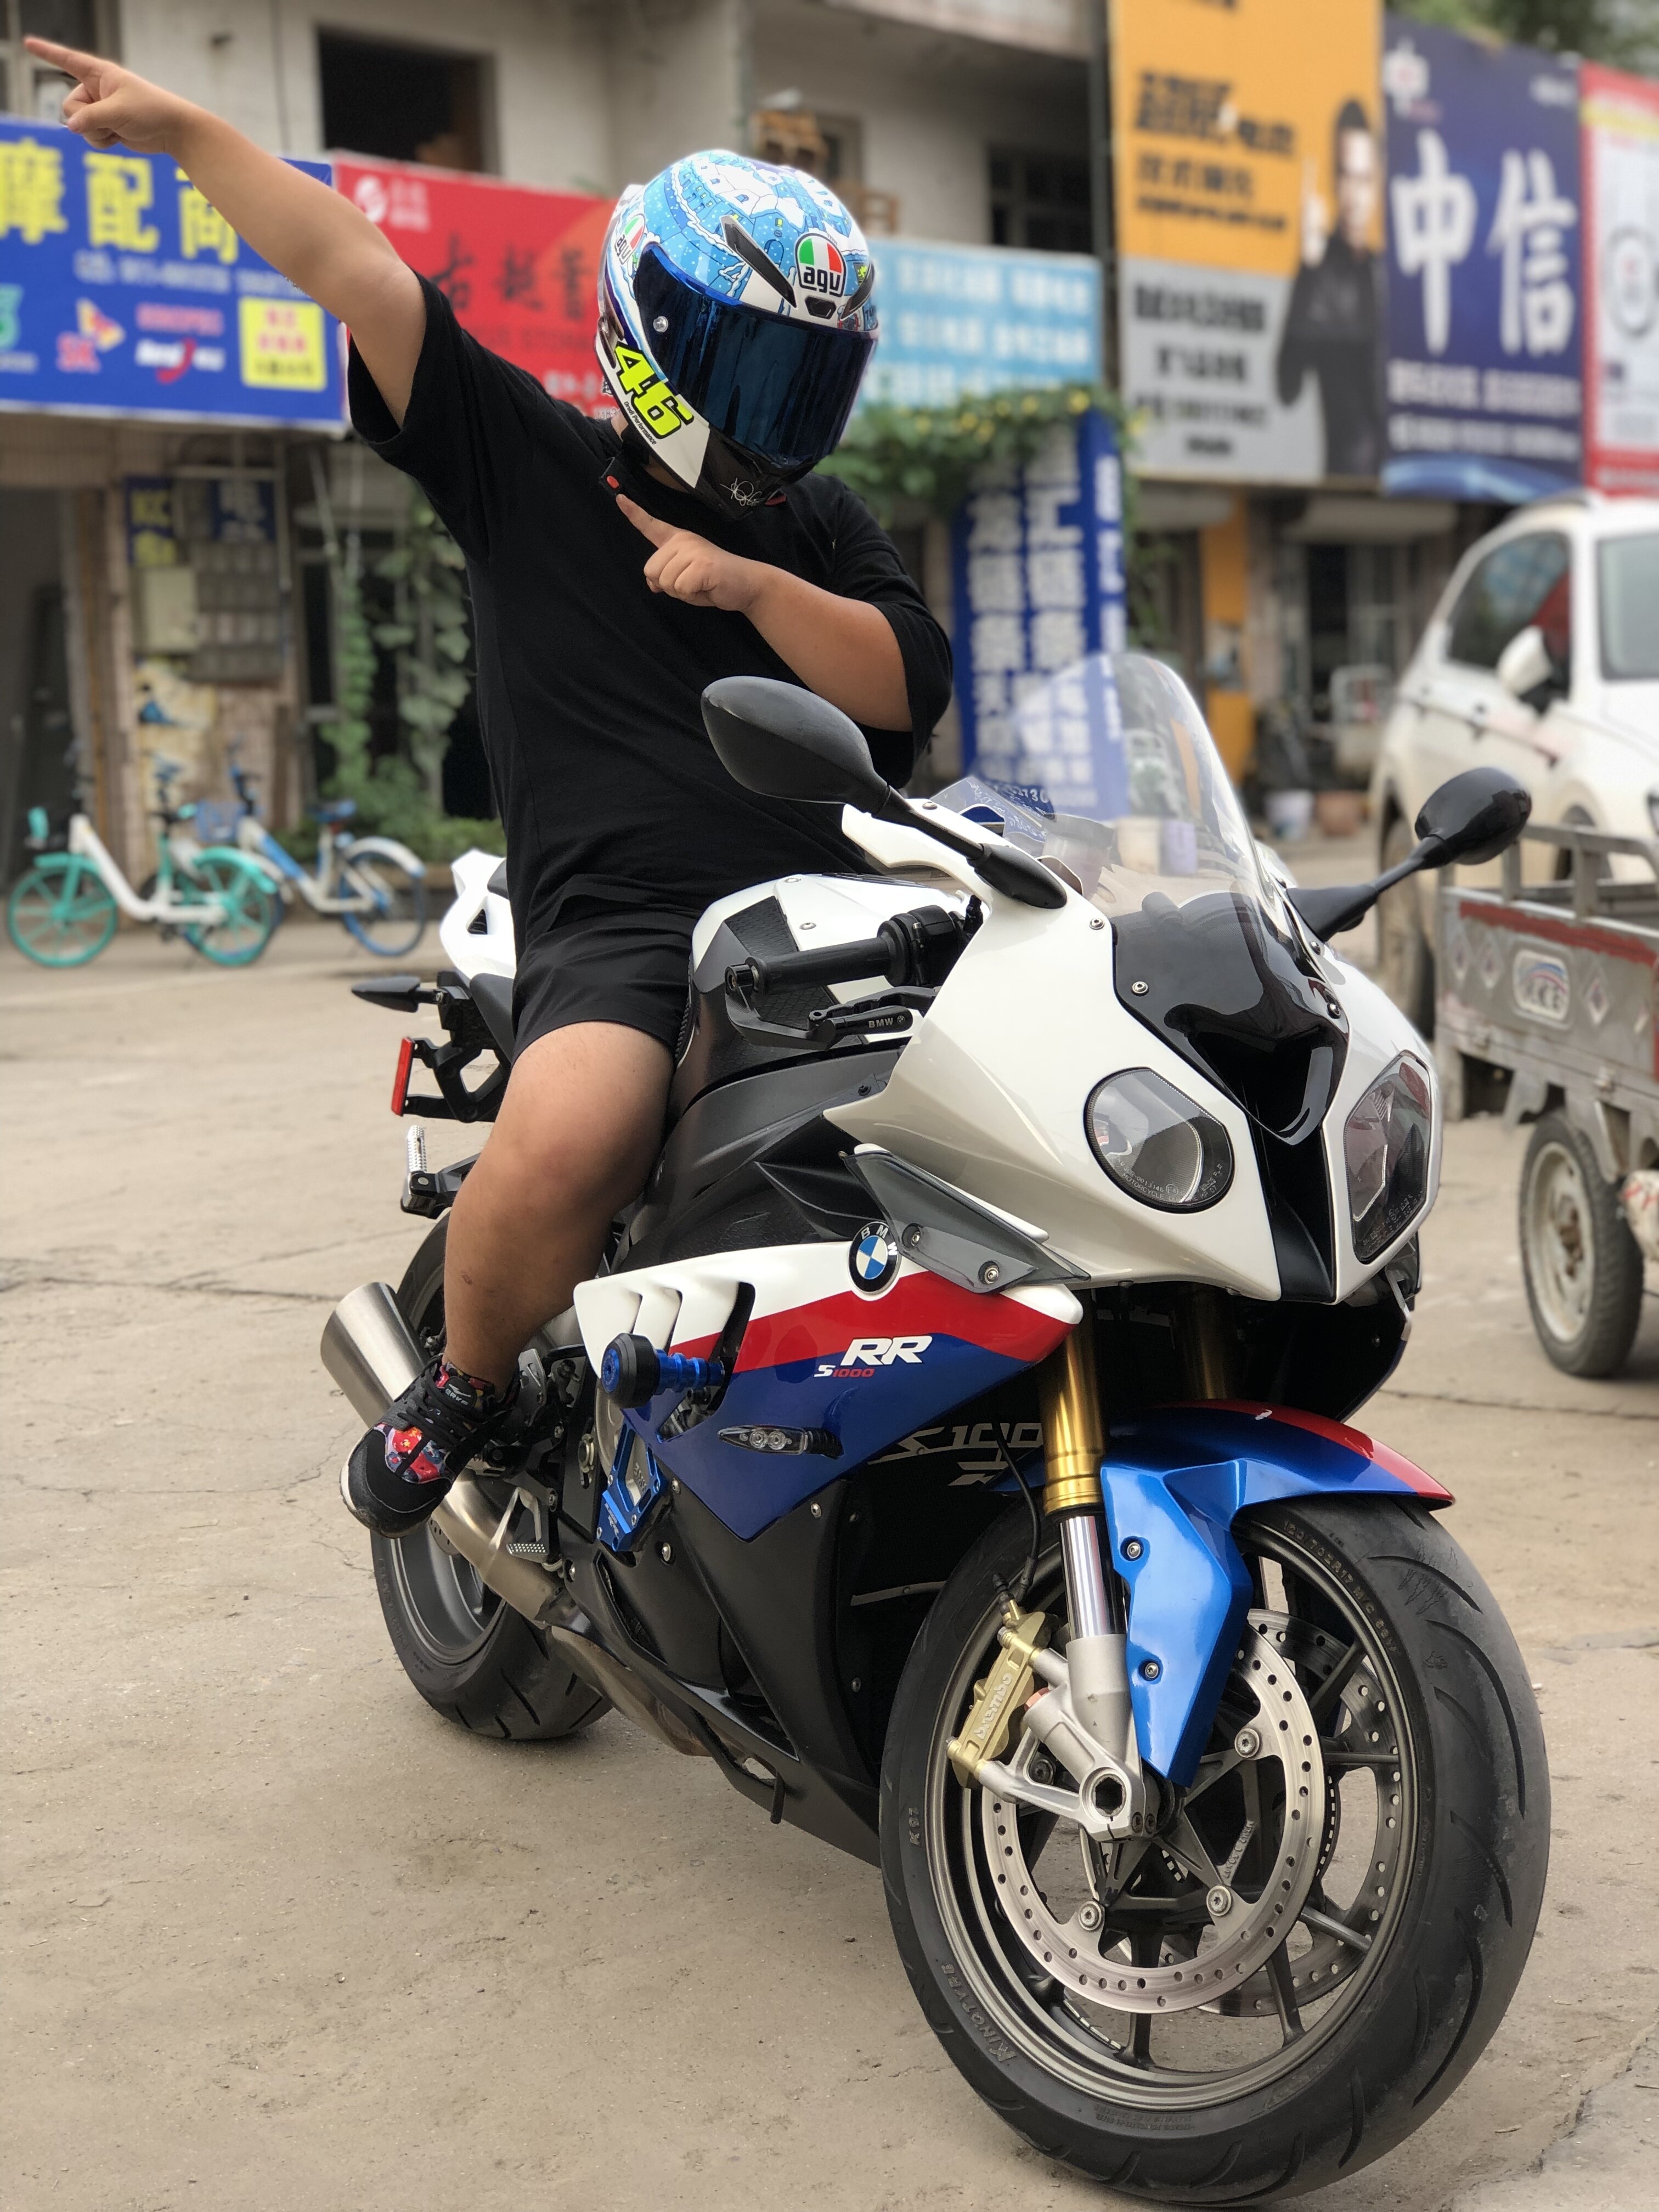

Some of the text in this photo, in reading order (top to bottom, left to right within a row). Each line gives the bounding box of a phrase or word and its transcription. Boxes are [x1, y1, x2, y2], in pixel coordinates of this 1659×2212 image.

[617, 234, 631, 259] agv
[1390, 128, 1579, 357] 中信
[803, 266, 841, 294] agv
[615, 342, 694, 439] 46
[632, 414, 657, 445] Performance
[868, 1018, 894, 1028] BMW
[1122, 1172, 1164, 1200] MOTORCYCLE
[861, 1224, 898, 1255] BMW
[814, 1335, 933, 1378] S1000 RR
[973, 1673, 1013, 1740] brembo
[940, 1963, 1018, 2063] KINGTYRE
